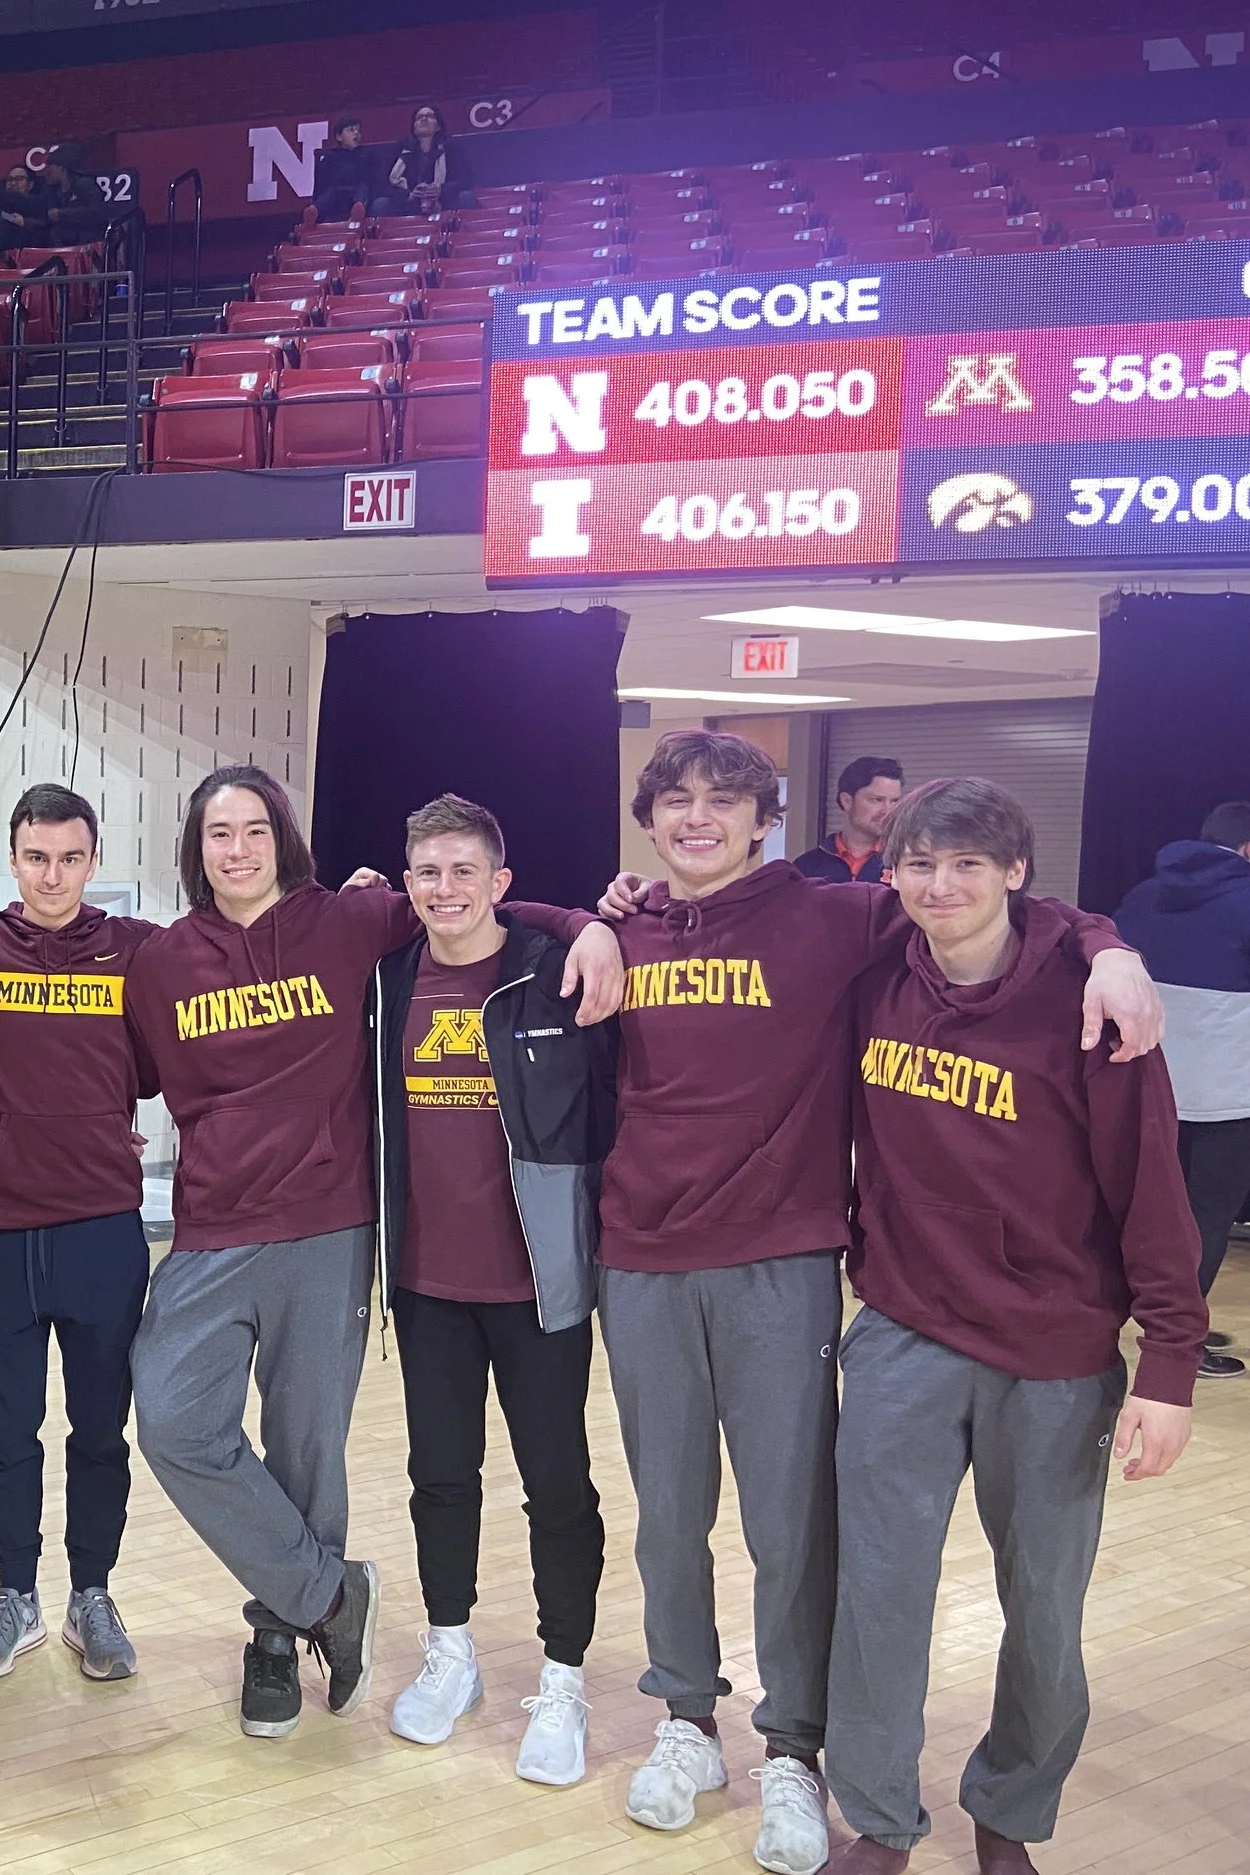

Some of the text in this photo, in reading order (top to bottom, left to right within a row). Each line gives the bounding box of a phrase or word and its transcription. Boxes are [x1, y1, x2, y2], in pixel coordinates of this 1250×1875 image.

[953, 52, 1000, 81] C4
[469, 100, 513, 128] C3
[26, 145, 59, 171] C
[518, 276, 881, 345] TEAM SCORE
[521, 369, 876, 456] N 408.050
[349, 478, 411, 523] EXIT
[529, 478, 860, 558] I 406.150
[743, 641, 788, 672] EXIT
[620, 958, 771, 1012] INNESOTA
[175, 974, 334, 1041] MINNESOTA
[408, 1094, 479, 1106] GYMNASTICS
[432, 1079, 489, 1090] MINNESOTA
